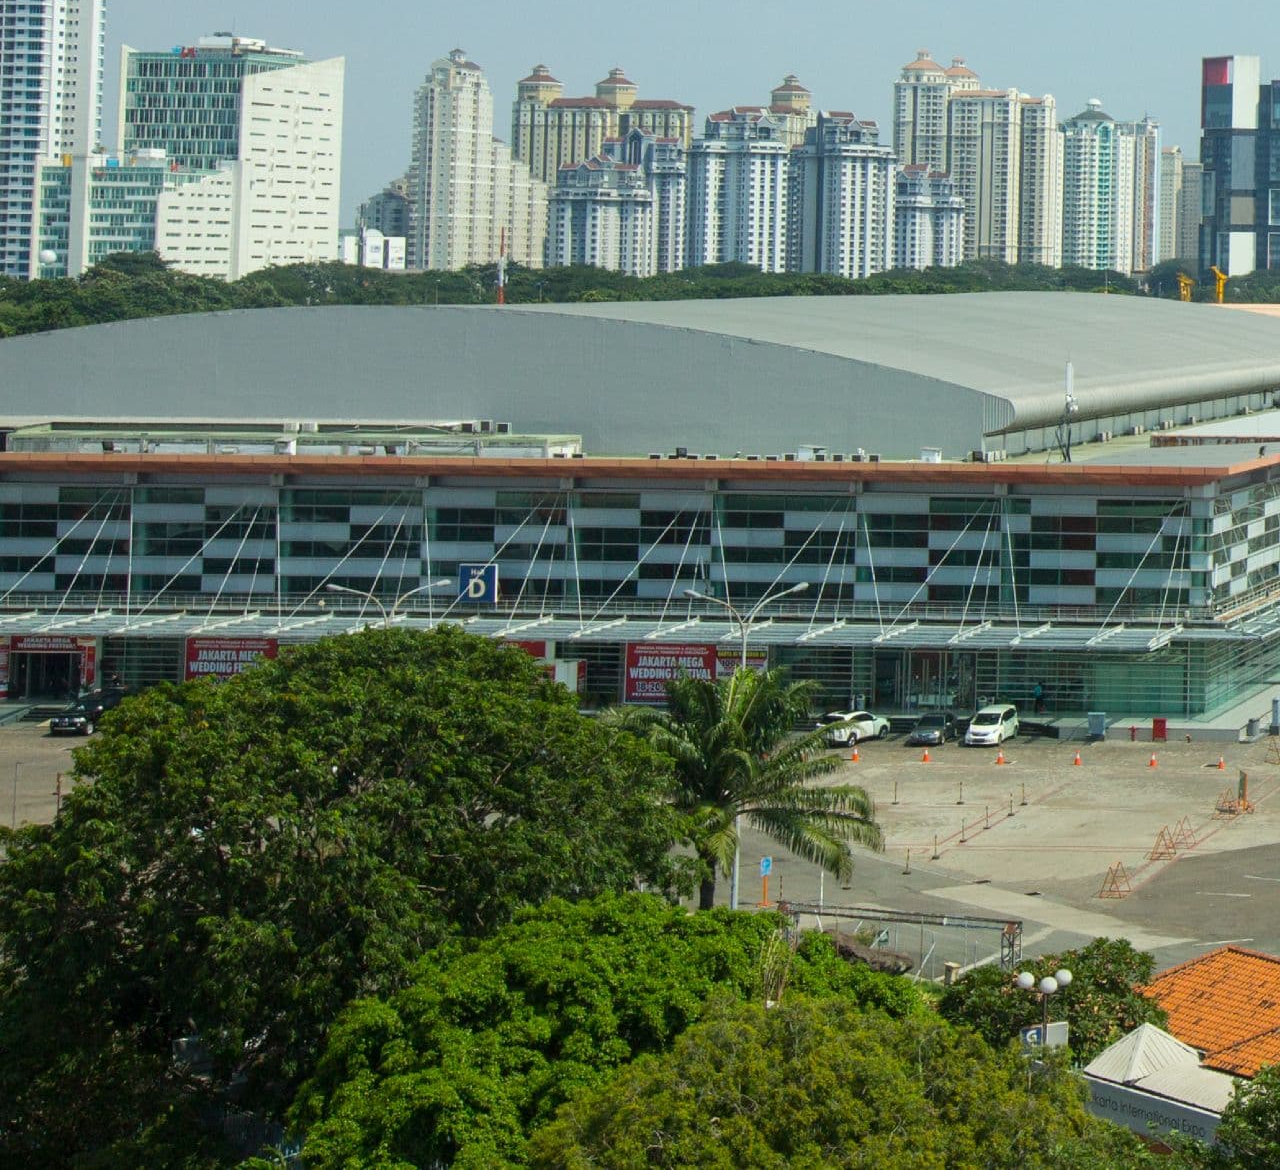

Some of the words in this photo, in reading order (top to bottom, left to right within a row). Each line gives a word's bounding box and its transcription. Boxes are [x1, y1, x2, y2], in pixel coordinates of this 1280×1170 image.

[468, 578, 486, 598] D
[197, 650, 237, 661] JAKARTA
[189, 661, 233, 673] WEDDING
[637, 656, 677, 667] JAKARTA
[678, 656, 704, 668] MEGA
[629, 667, 672, 679] WEDDING
[1092, 1093, 1118, 1111] karta
[1120, 1101, 1180, 1129] International
[1182, 1118, 1206, 1137] Expo
